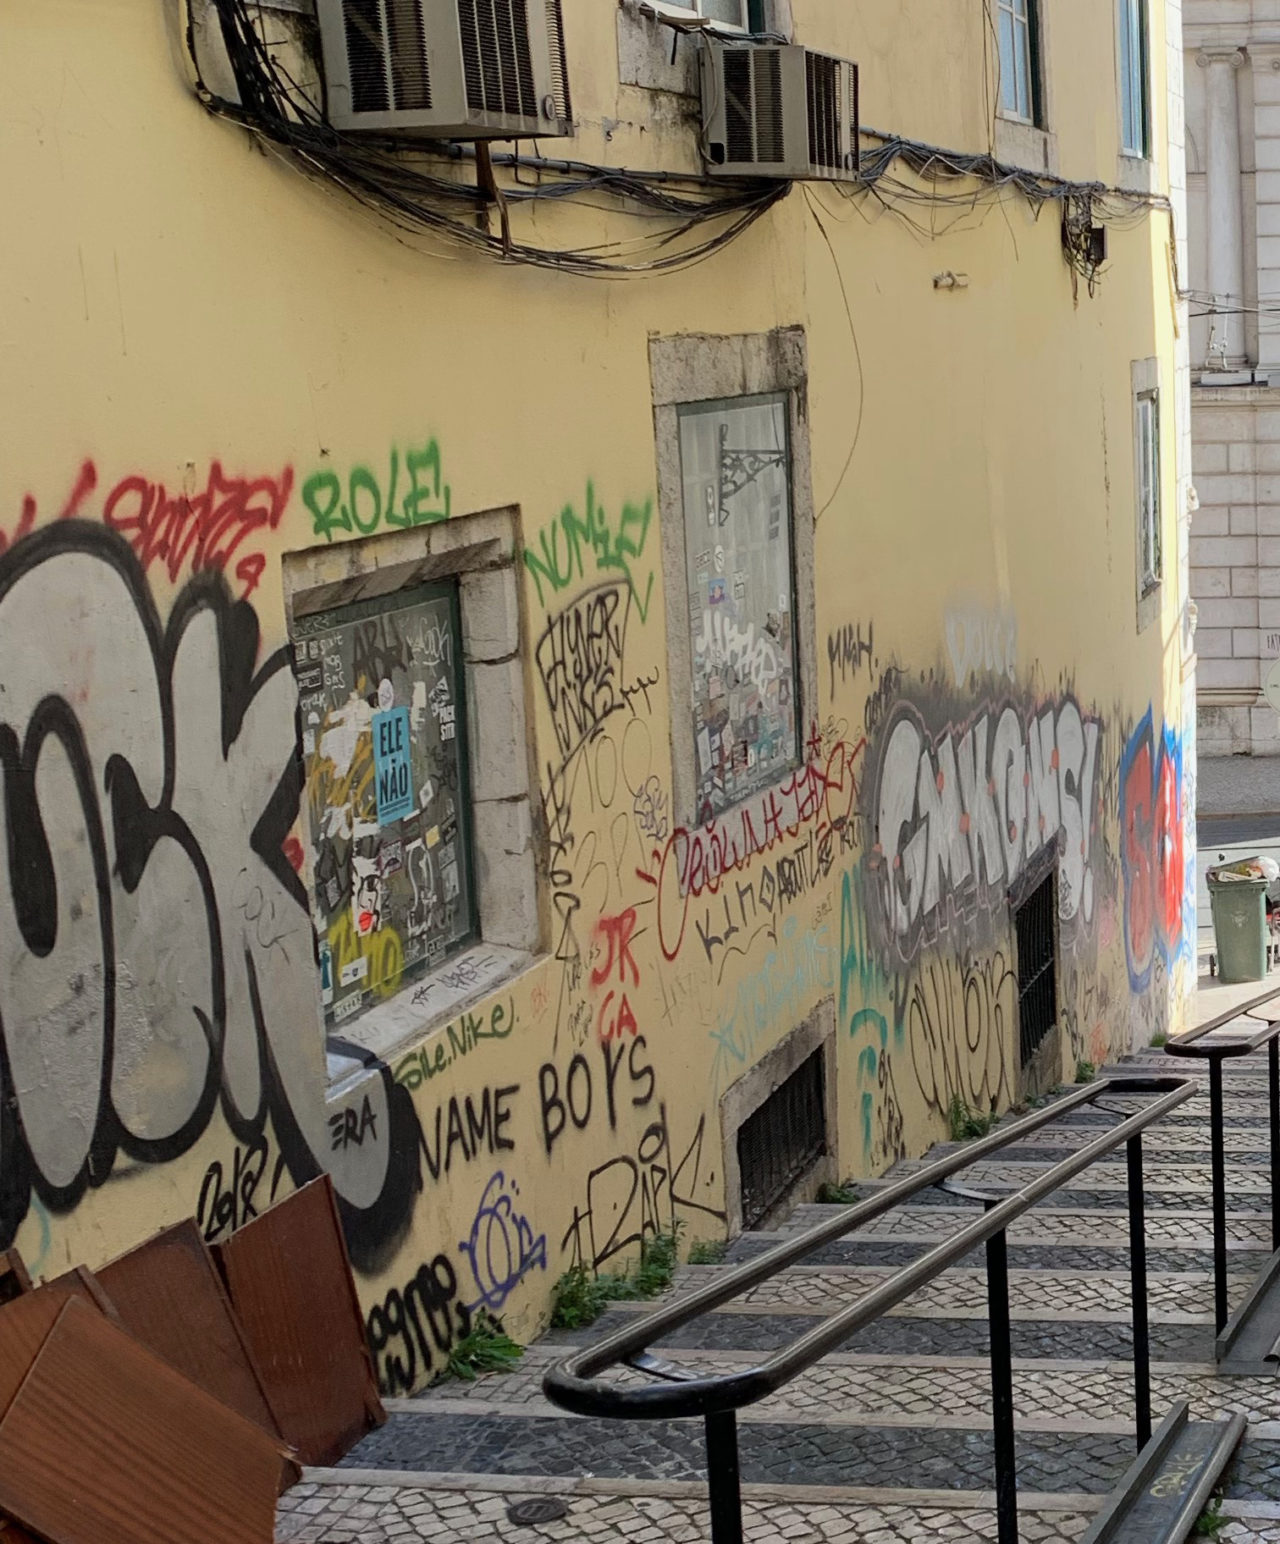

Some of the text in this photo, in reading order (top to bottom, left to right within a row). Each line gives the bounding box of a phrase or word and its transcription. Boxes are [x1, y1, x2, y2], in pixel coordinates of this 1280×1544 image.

[302, 436, 452, 542] ROLE
[379, 716, 403, 758] ELE
[379, 757, 410, 806] NÃO
[538, 1034, 657, 1159] BOYS
